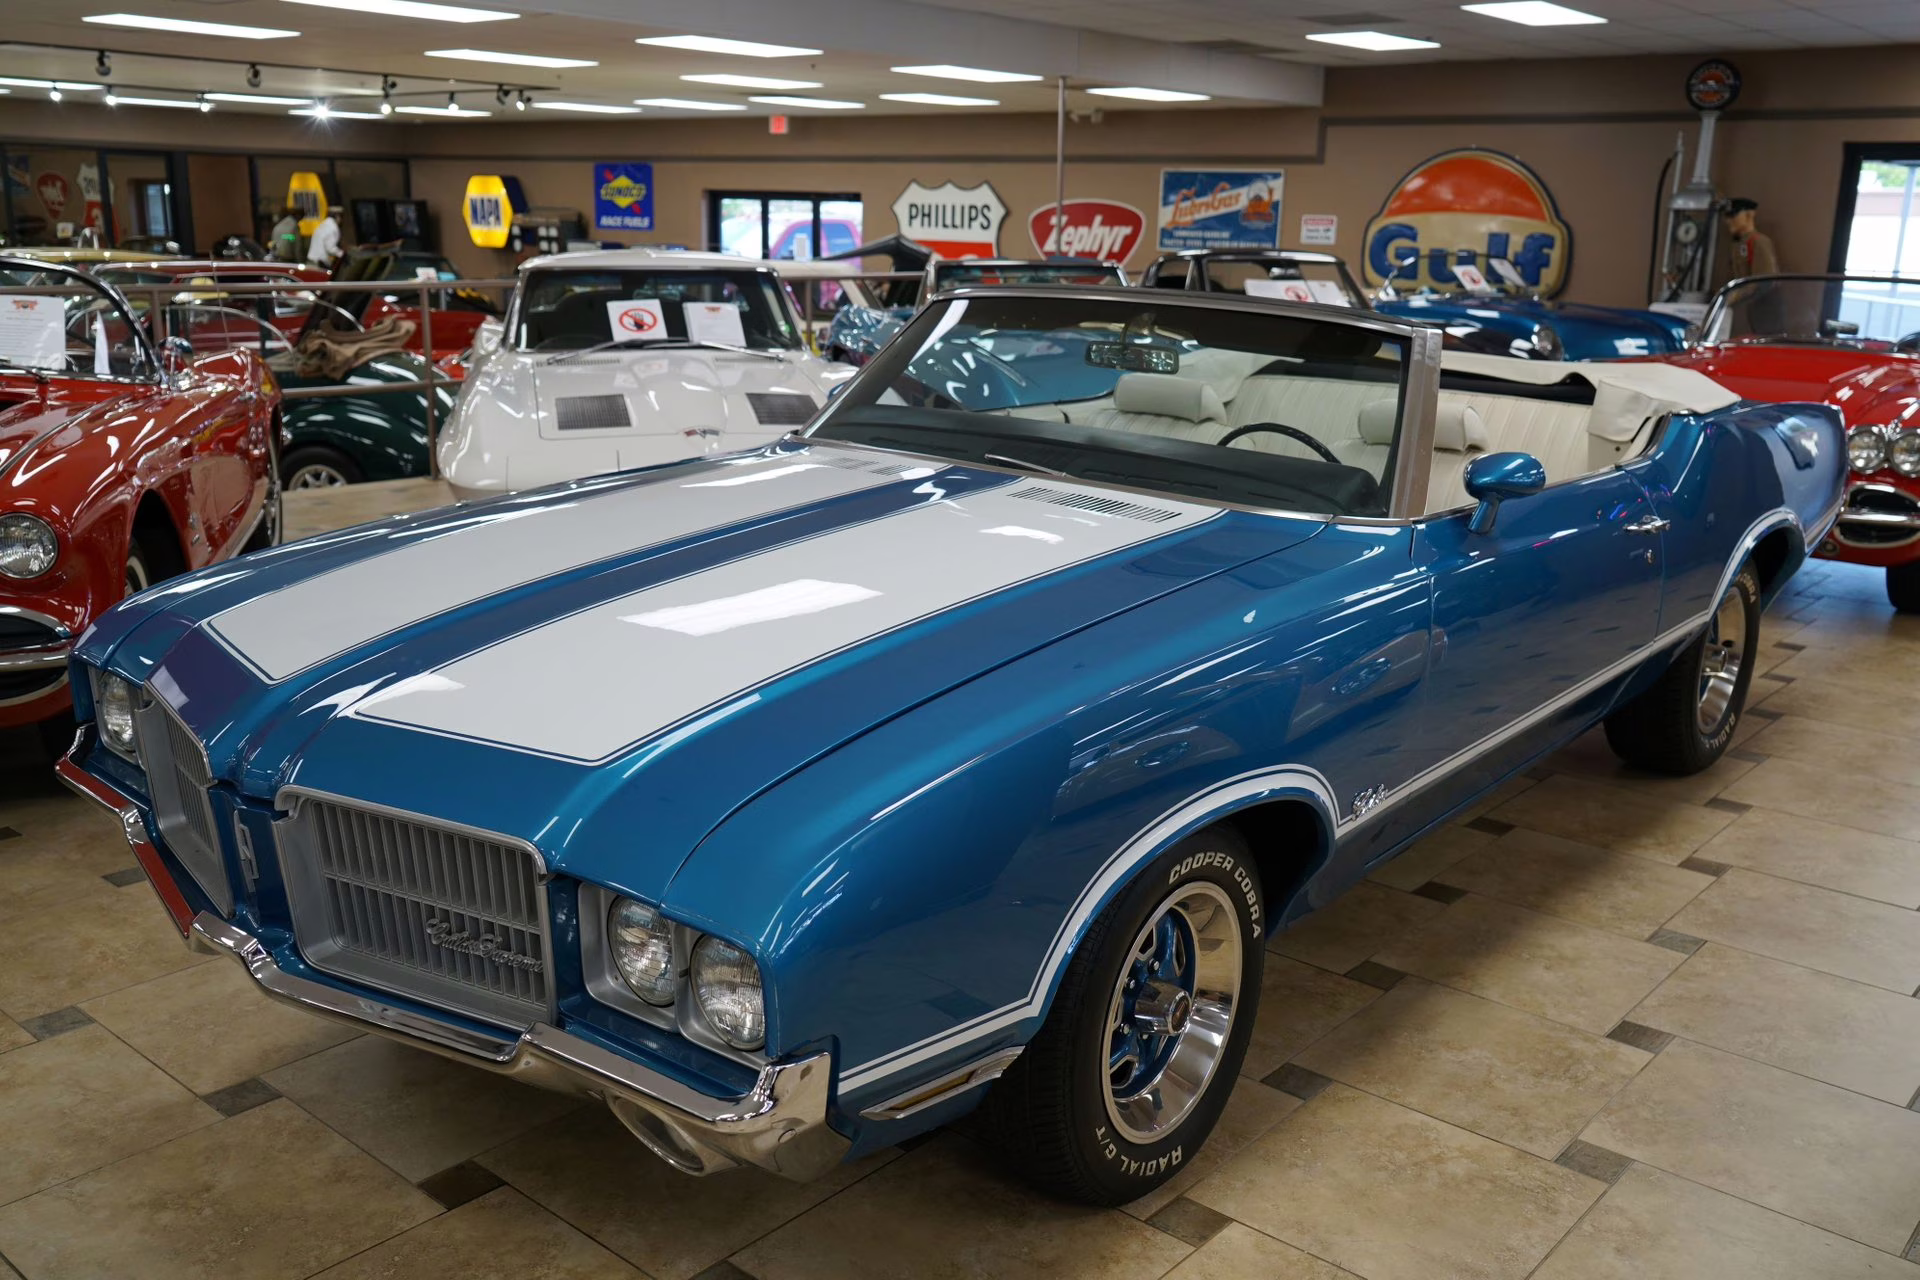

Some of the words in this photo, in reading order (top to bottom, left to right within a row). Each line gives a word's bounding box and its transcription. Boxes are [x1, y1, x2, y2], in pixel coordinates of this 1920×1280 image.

[470, 197, 502, 227] NAPA
[908, 203, 991, 230] PHILLIPS
[1041, 214, 1134, 261] Zephyr
[1369, 223, 1555, 287] Gulf
[1168, 851, 1234, 885] COOPER
[1233, 866, 1262, 939] COBRA
[1095, 1126, 1117, 1159] G/T
[1119, 1145, 1182, 1176] RADIAL
